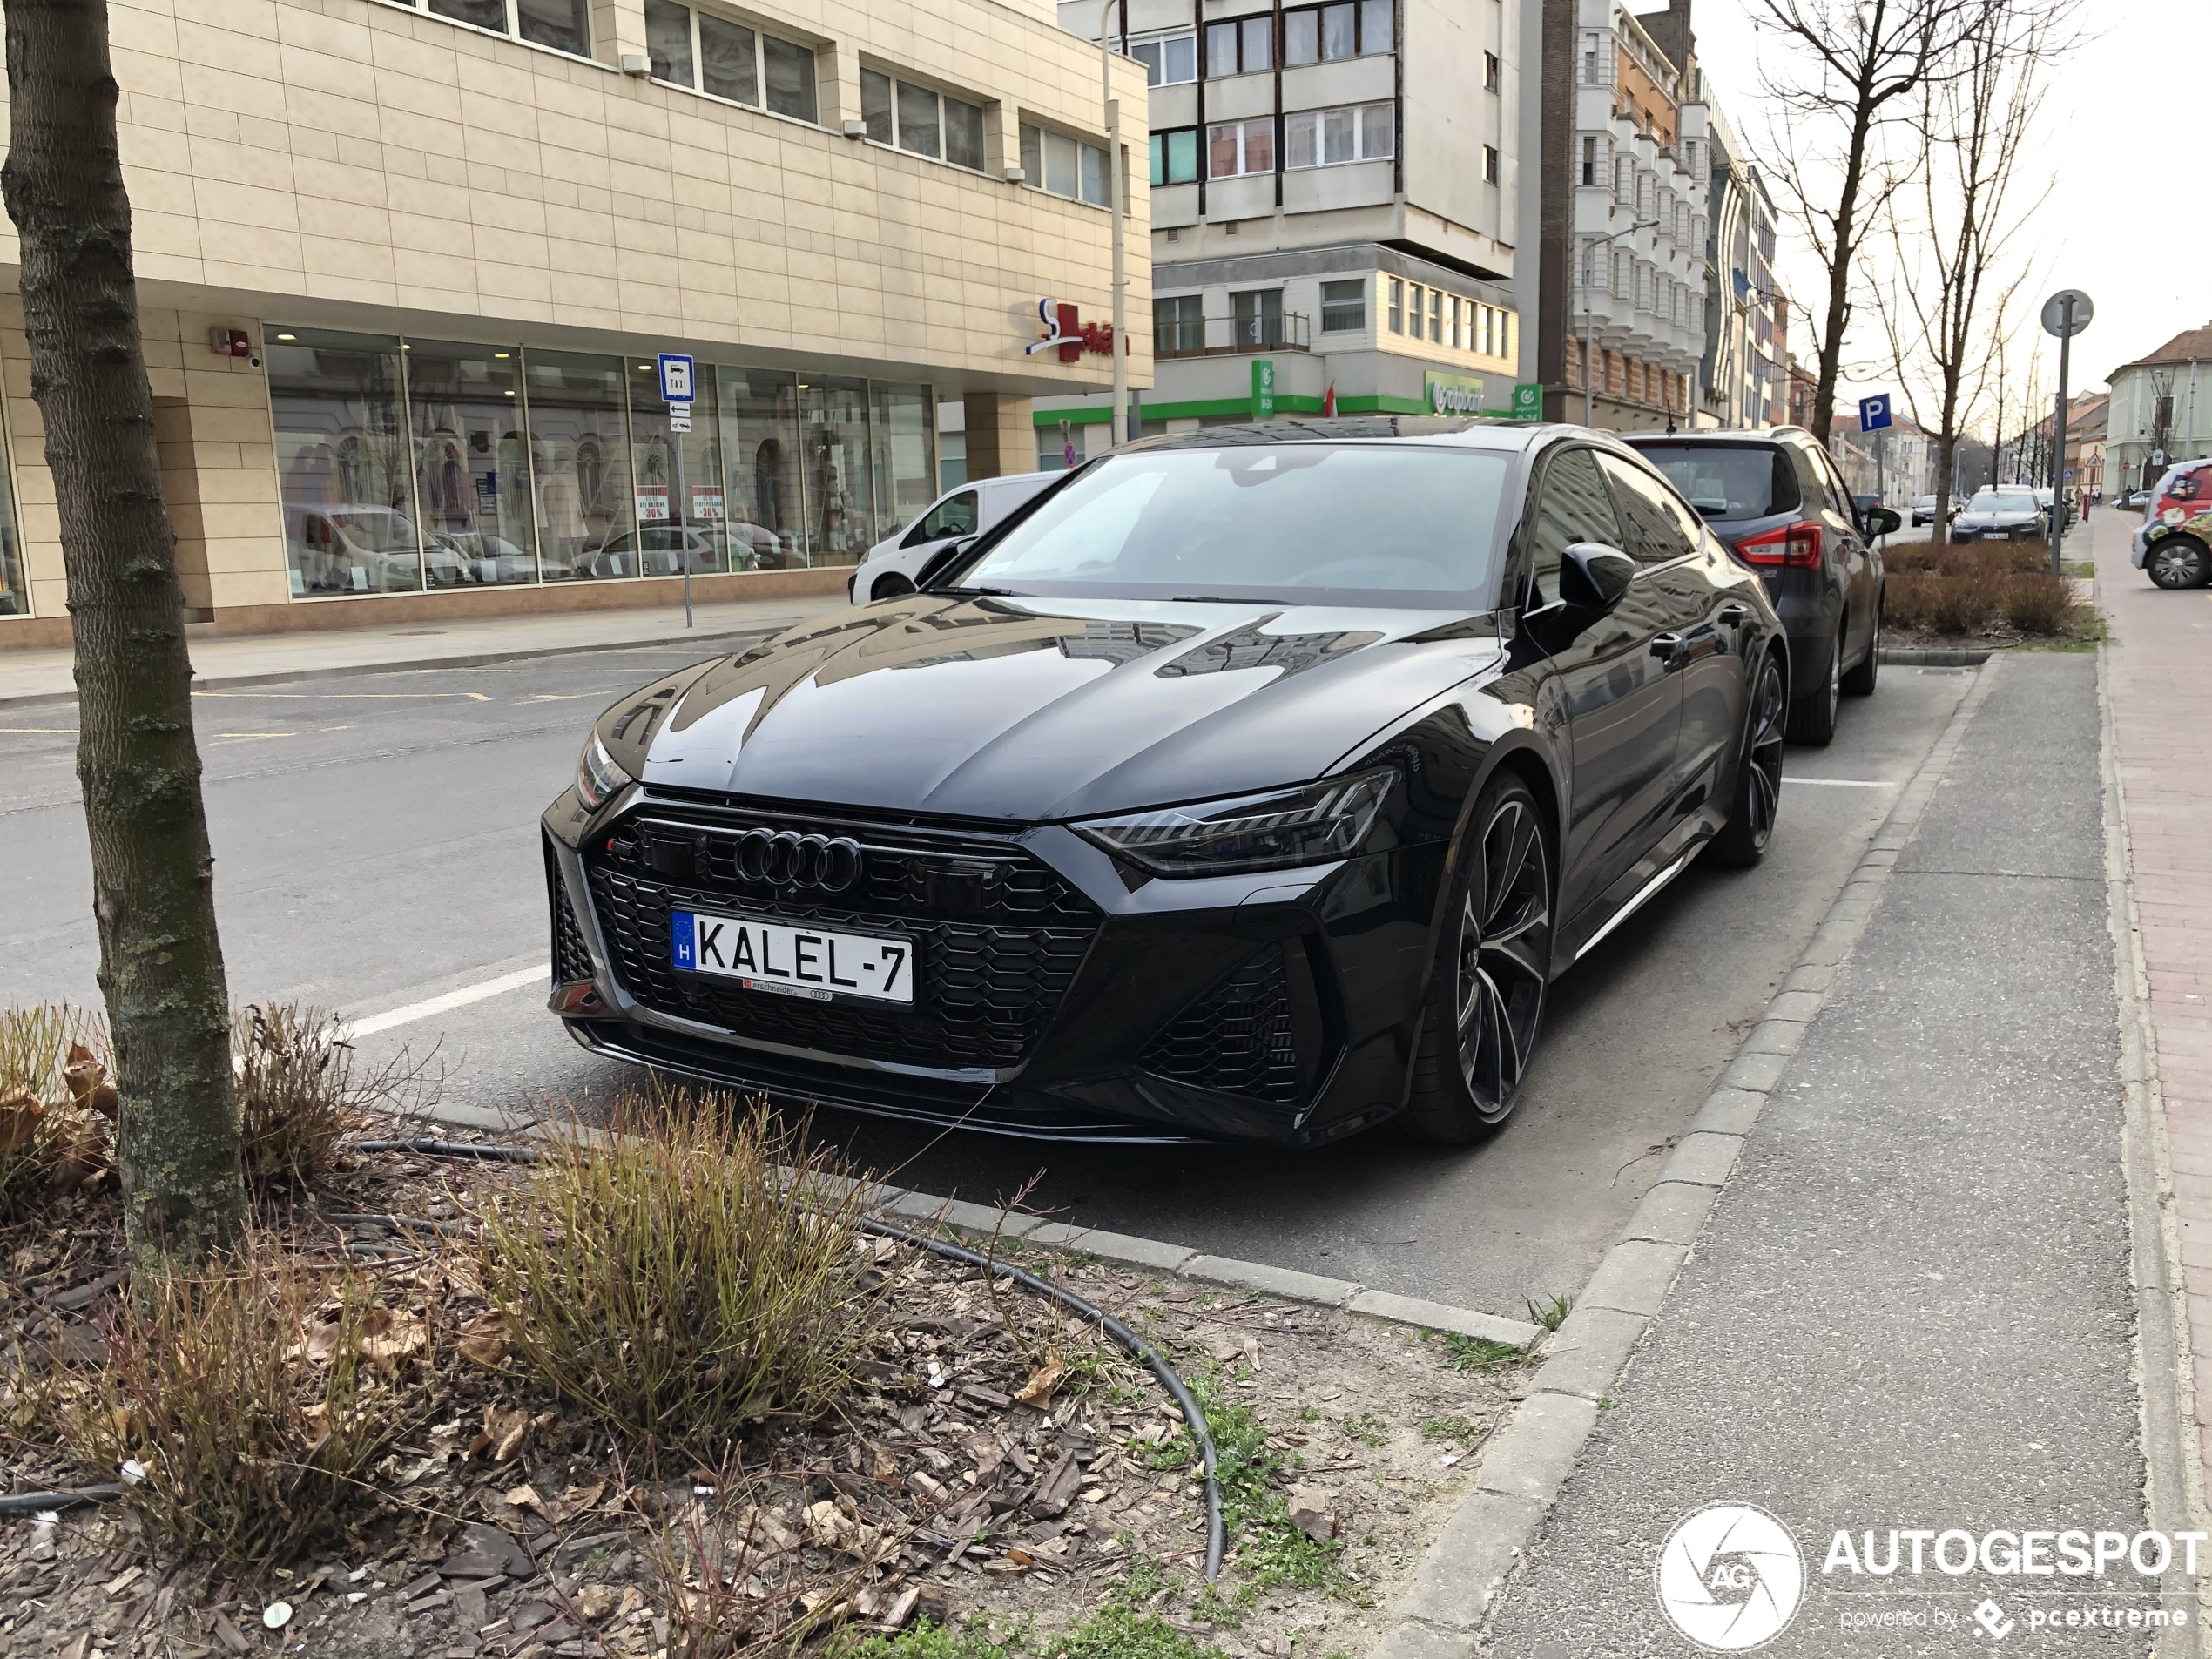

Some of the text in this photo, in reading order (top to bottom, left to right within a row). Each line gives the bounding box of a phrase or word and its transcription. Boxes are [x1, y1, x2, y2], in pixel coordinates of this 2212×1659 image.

[670, 379, 686, 389] TAXI
[1866, 401, 1884, 428] P
[643, 508, 664, 518] -30%
[700, 507, 718, 517] -30%
[678, 944, 690, 961] H
[699, 921, 905, 992] KALEL-7
